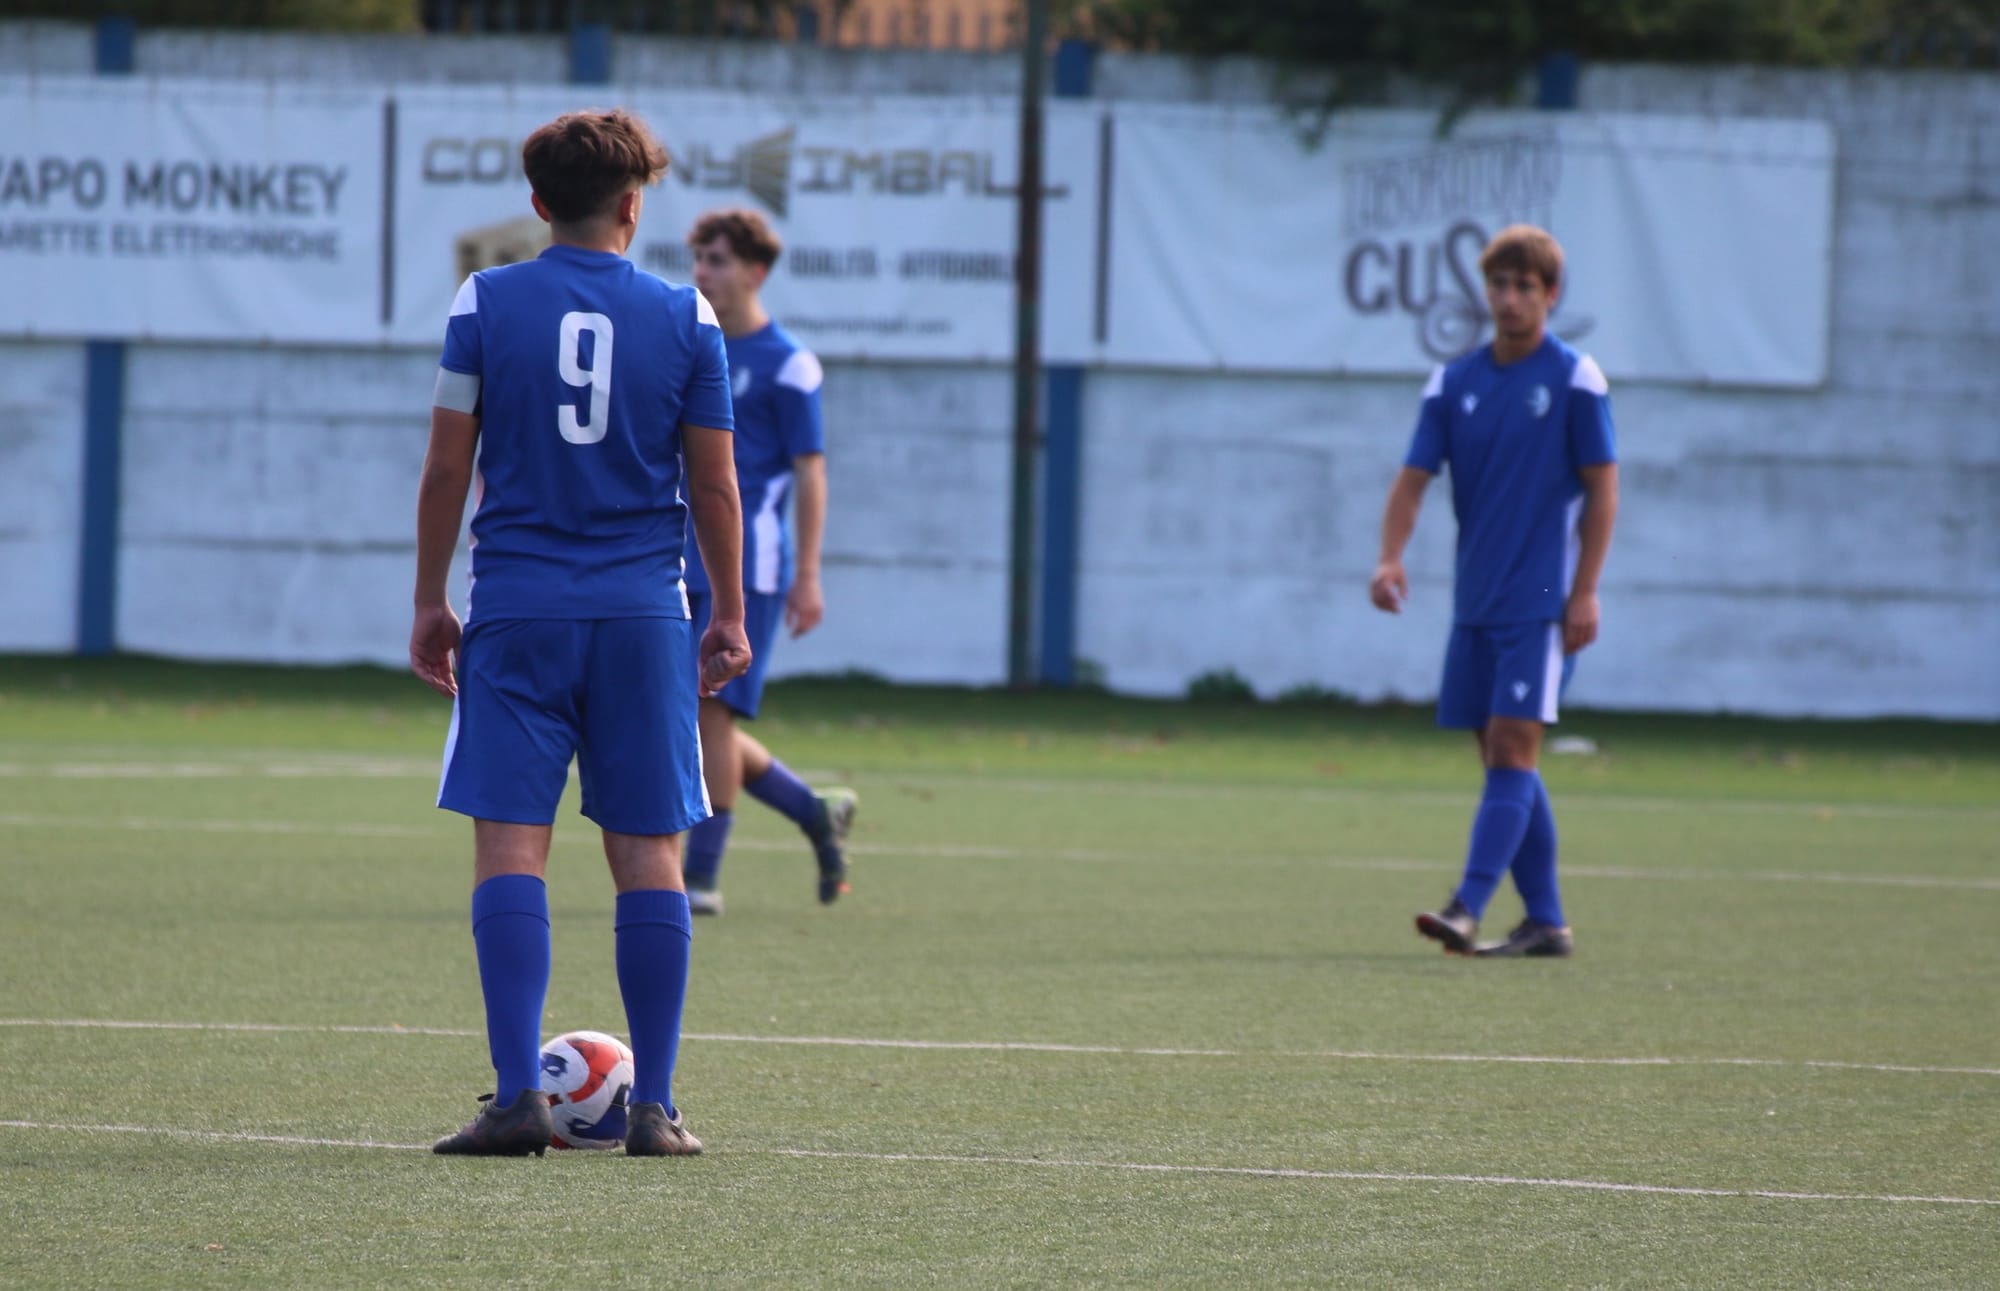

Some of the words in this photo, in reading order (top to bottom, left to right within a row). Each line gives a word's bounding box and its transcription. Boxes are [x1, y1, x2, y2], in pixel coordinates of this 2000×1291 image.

[0, 157, 106, 209] APO
[123, 160, 348, 214] MONKEY
[558, 311, 614, 444] 9
